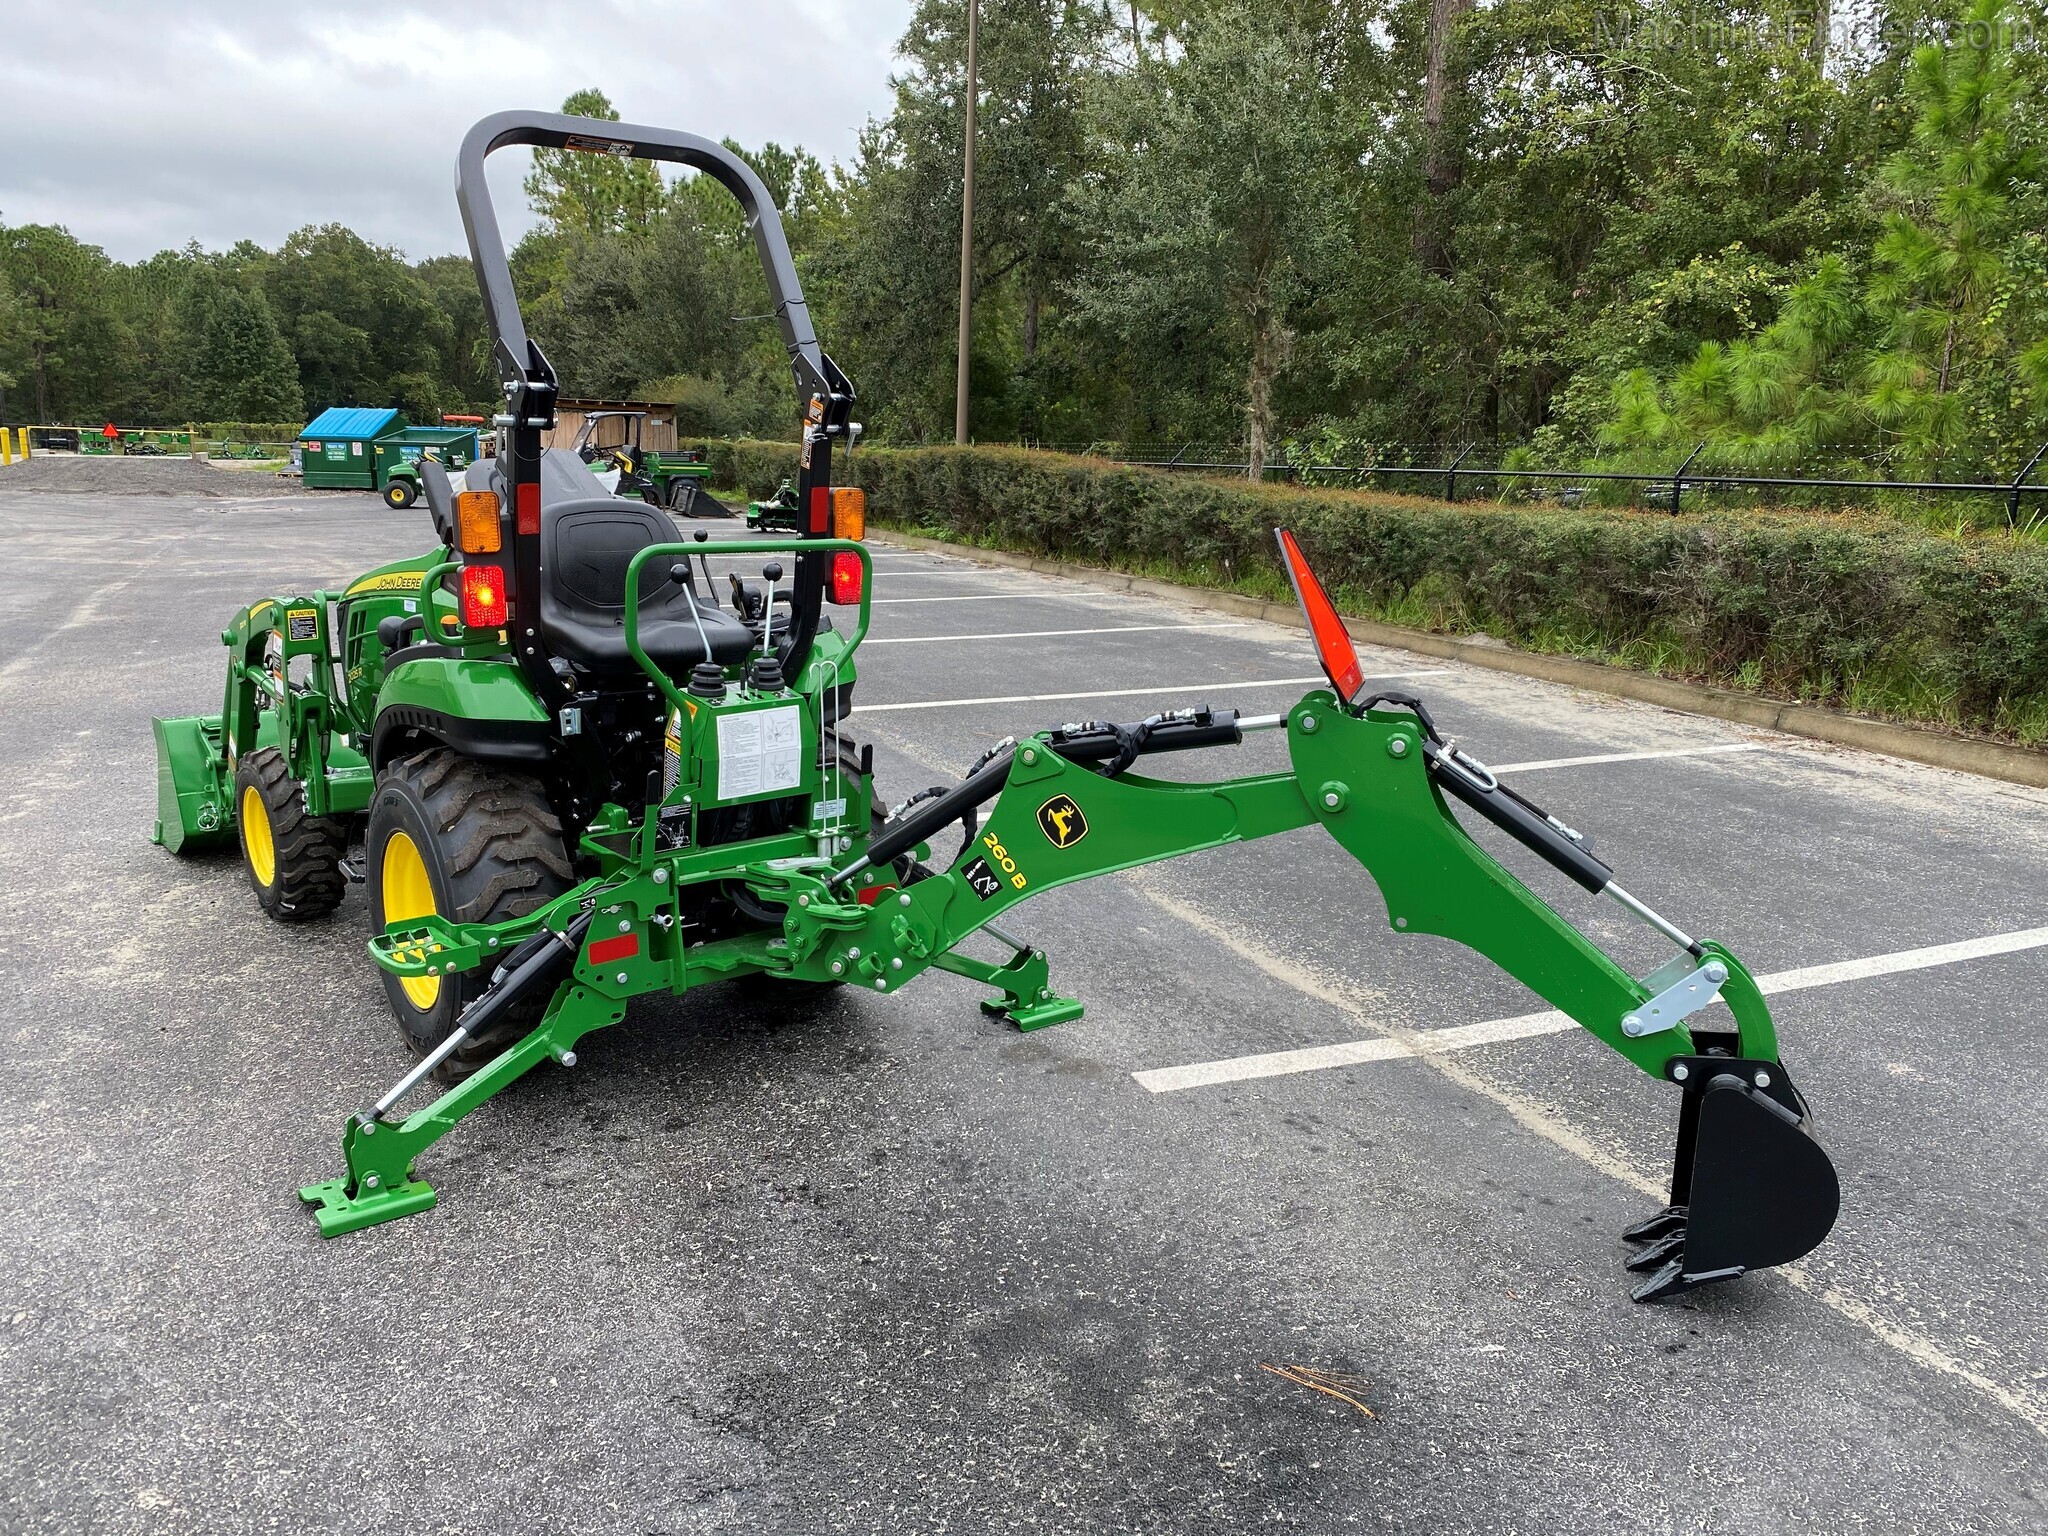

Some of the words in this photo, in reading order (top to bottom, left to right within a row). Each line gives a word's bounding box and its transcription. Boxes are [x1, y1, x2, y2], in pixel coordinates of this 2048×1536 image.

[377, 578, 397, 588] JOHN
[397, 576, 422, 588] DEERE
[982, 831, 1017, 874] 260
[1009, 871, 1028, 890] B
